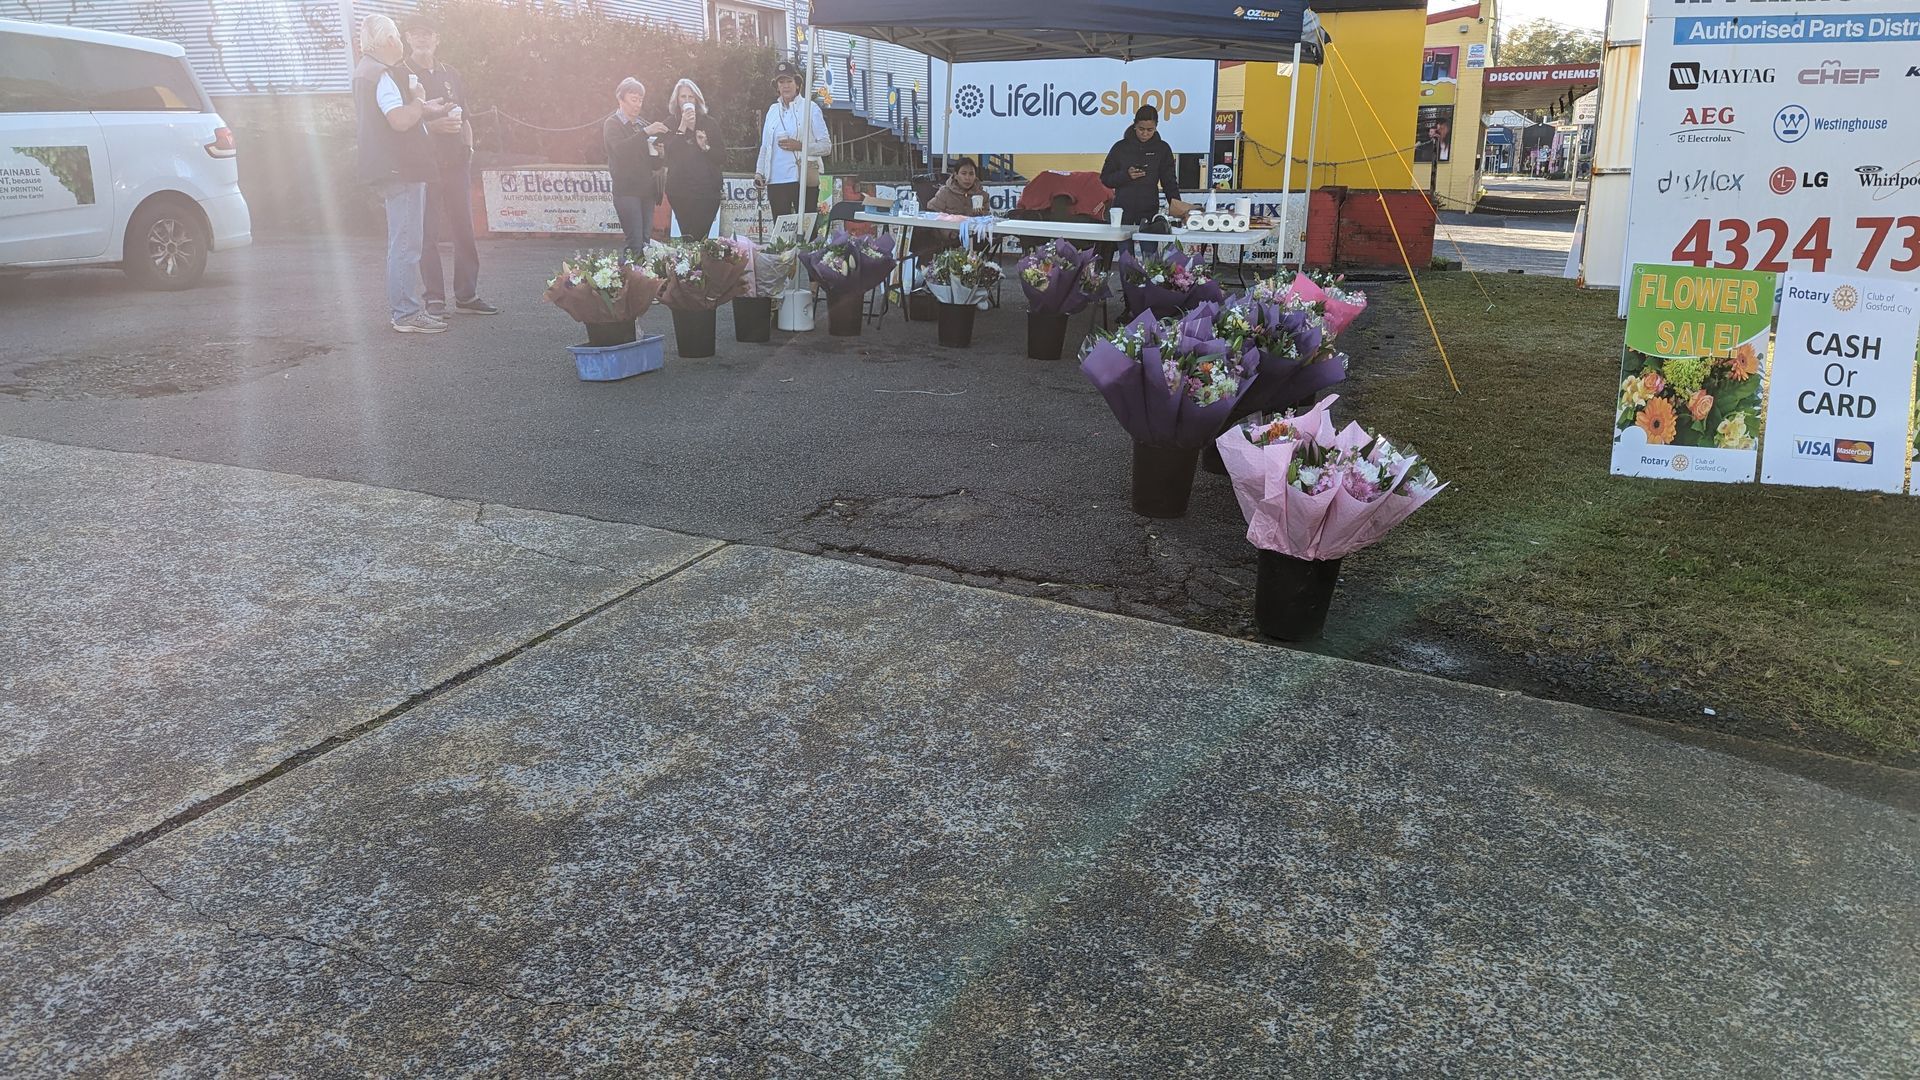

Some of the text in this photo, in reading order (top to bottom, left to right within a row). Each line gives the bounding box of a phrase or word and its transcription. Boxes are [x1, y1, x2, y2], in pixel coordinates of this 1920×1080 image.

[1689, 20, 1804, 40] Authorised
[1809, 20, 1864, 37] Parts
[1489, 71, 1548, 82] DISCOUNT
[1702, 68, 1776, 84] MAYTAG
[1798, 69, 1880, 84] CHEF
[1681, 107, 1735, 124] AEG
[1814, 118, 1888, 132] Westinghouse
[1688, 134, 1732, 143] Electrolux
[1803, 172, 1829, 188] LG
[1671, 218, 1832, 273] 4324
[1638, 274, 1760, 315] FLOWER
[1789, 286, 1829, 304] Rotary
[1867, 293, 1895, 302] Club of
[1865, 302, 1912, 315] Gosford City
[1655, 321, 1740, 358] SALE!
[1806, 331, 1881, 360] CASH
[1824, 363, 1858, 387] Or
[1798, 390, 1877, 418] CARD
[1796, 440, 1831, 457] VISA
[1836, 447, 1872, 456] MasterCard
[1640, 456, 1670, 467] Rotary
